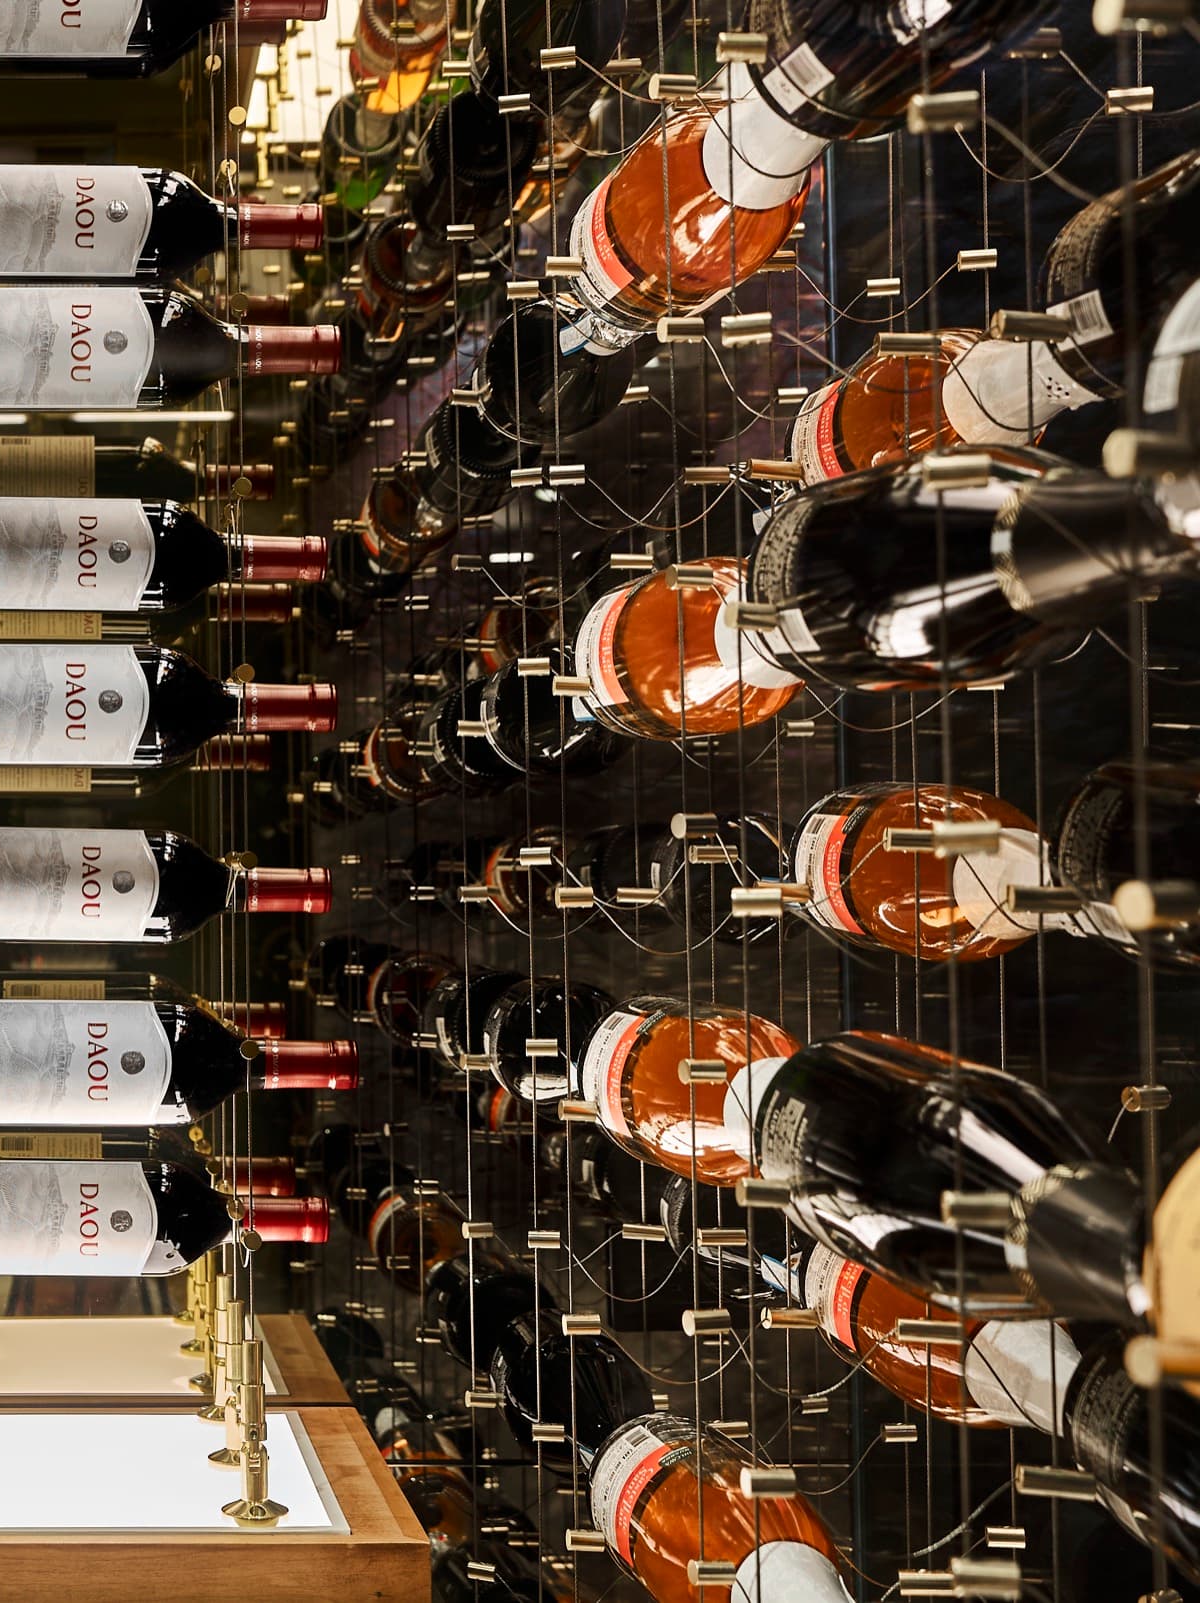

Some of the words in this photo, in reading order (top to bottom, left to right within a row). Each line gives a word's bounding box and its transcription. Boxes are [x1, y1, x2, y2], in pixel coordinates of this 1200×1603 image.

[75, 178, 95, 249] DAOU
[70, 304, 92, 383] DAOU
[821, 401, 836, 453] Castell
[829, 455, 839, 473] de
[77, 515, 98, 588] DAOU
[65, 663, 86, 740] DAOU
[81, 846, 102, 917] DAOU
[826, 844, 835, 875] Sant
[828, 840, 841, 891] Castell
[87, 1022, 109, 1101] DAOU
[610, 1040, 632, 1087] Castell
[79, 1183, 100, 1257] DAOU
[842, 1301, 849, 1320] de
[622, 1467, 654, 1513] Castell
[625, 1467, 647, 1496] Sant
[622, 1516, 628, 1536] de
